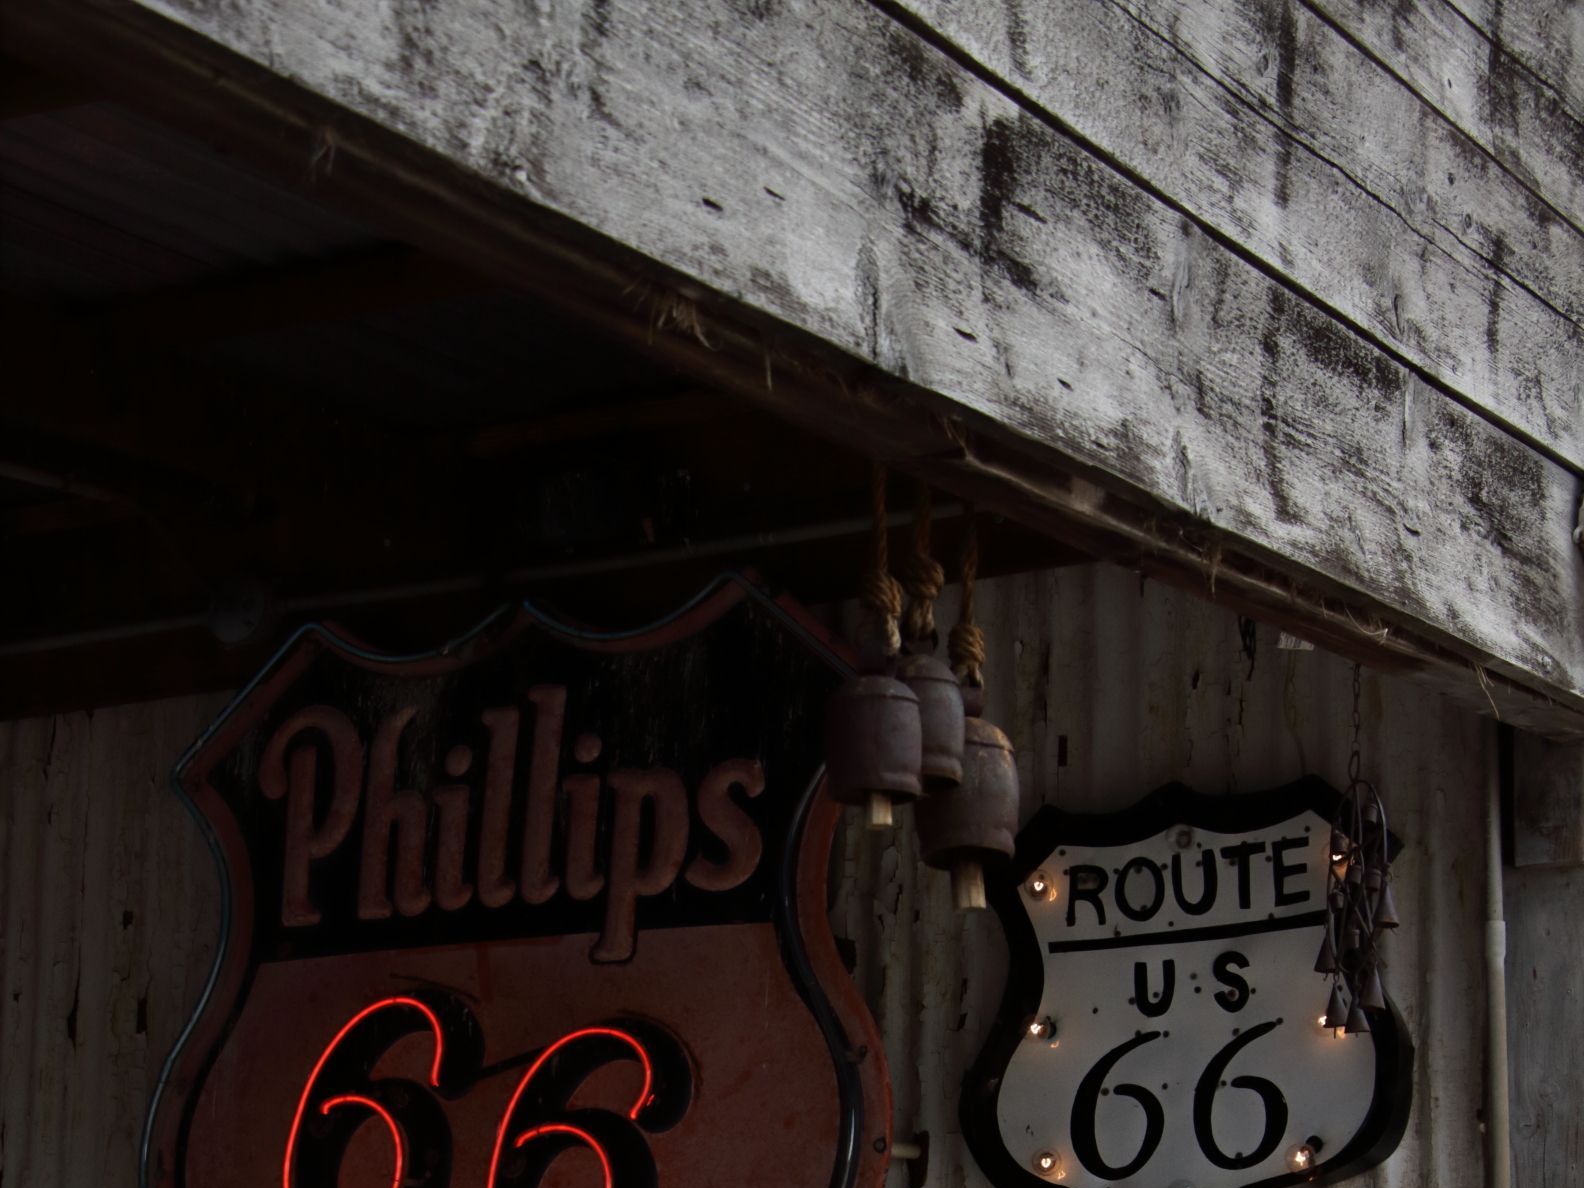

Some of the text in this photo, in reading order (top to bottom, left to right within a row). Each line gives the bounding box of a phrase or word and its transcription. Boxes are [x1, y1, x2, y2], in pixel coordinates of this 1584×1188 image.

[257, 682, 767, 963] Phillips
[1066, 836, 1311, 927] ROUTE
[1070, 1019, 1289, 1181] 66
